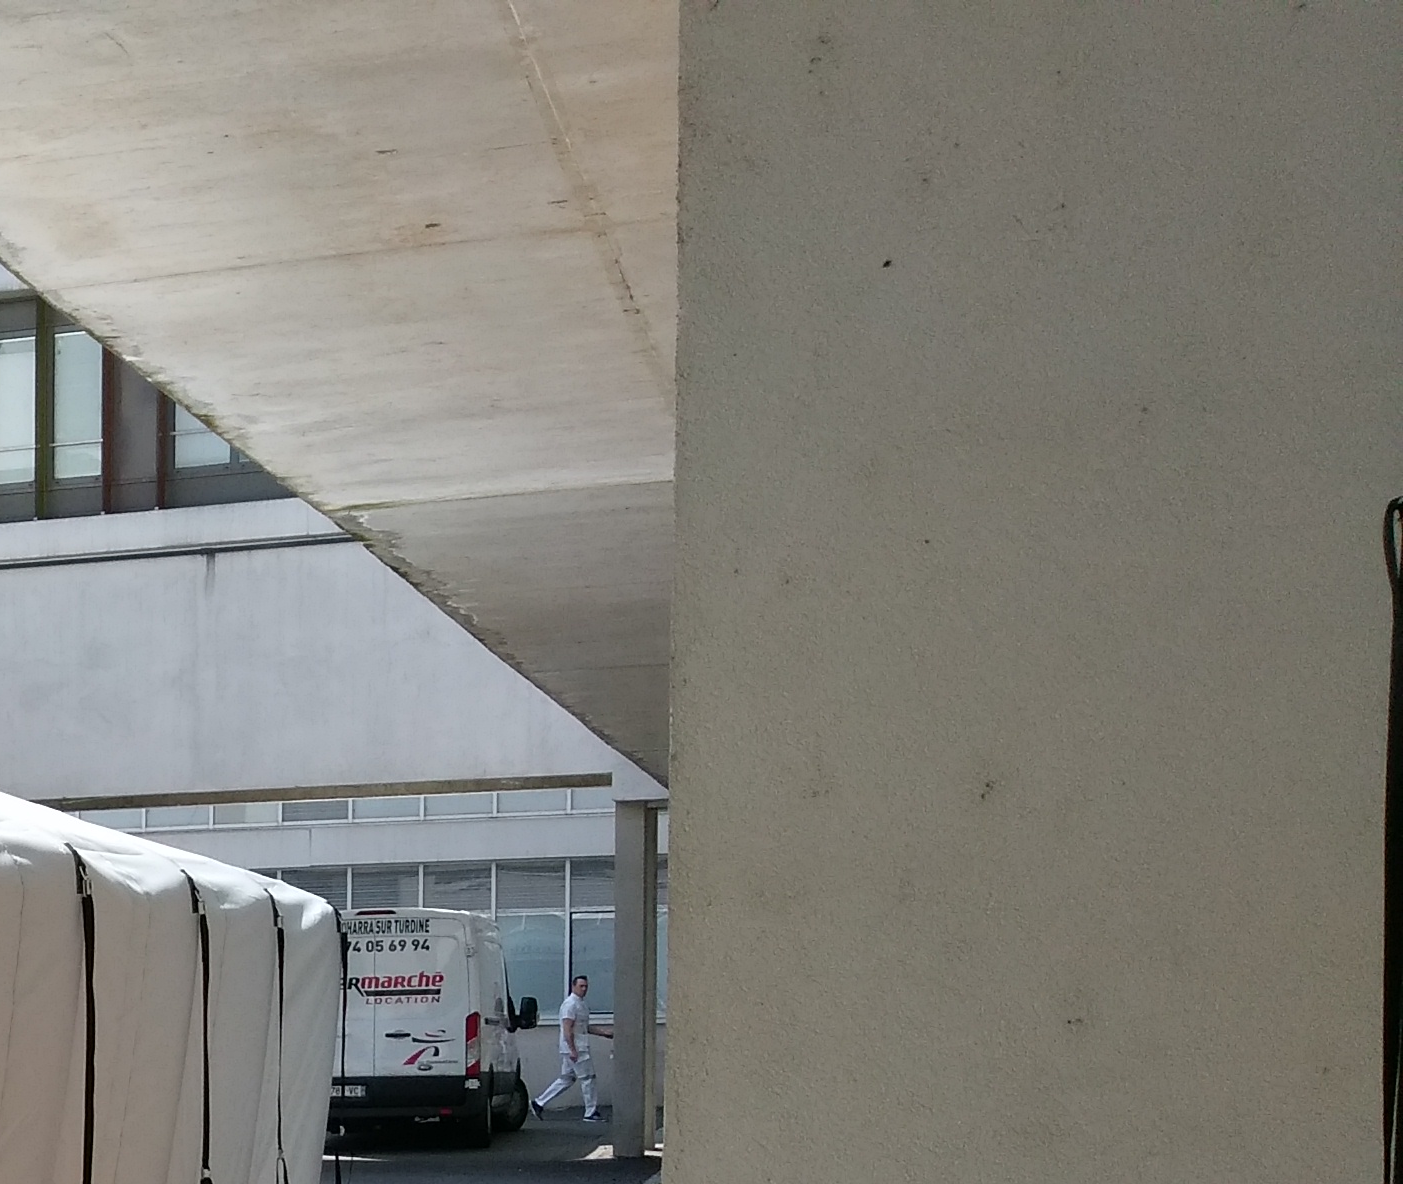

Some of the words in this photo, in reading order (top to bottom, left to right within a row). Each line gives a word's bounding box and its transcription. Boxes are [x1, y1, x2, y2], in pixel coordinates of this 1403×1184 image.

[375, 920, 393, 934] SUR
[394, 919, 430, 934] TURDINE
[365, 940, 384, 952] 05
[388, 939, 407, 952] 69
[411, 938, 430, 951] 94
[365, 996, 441, 1005] LOCATION
